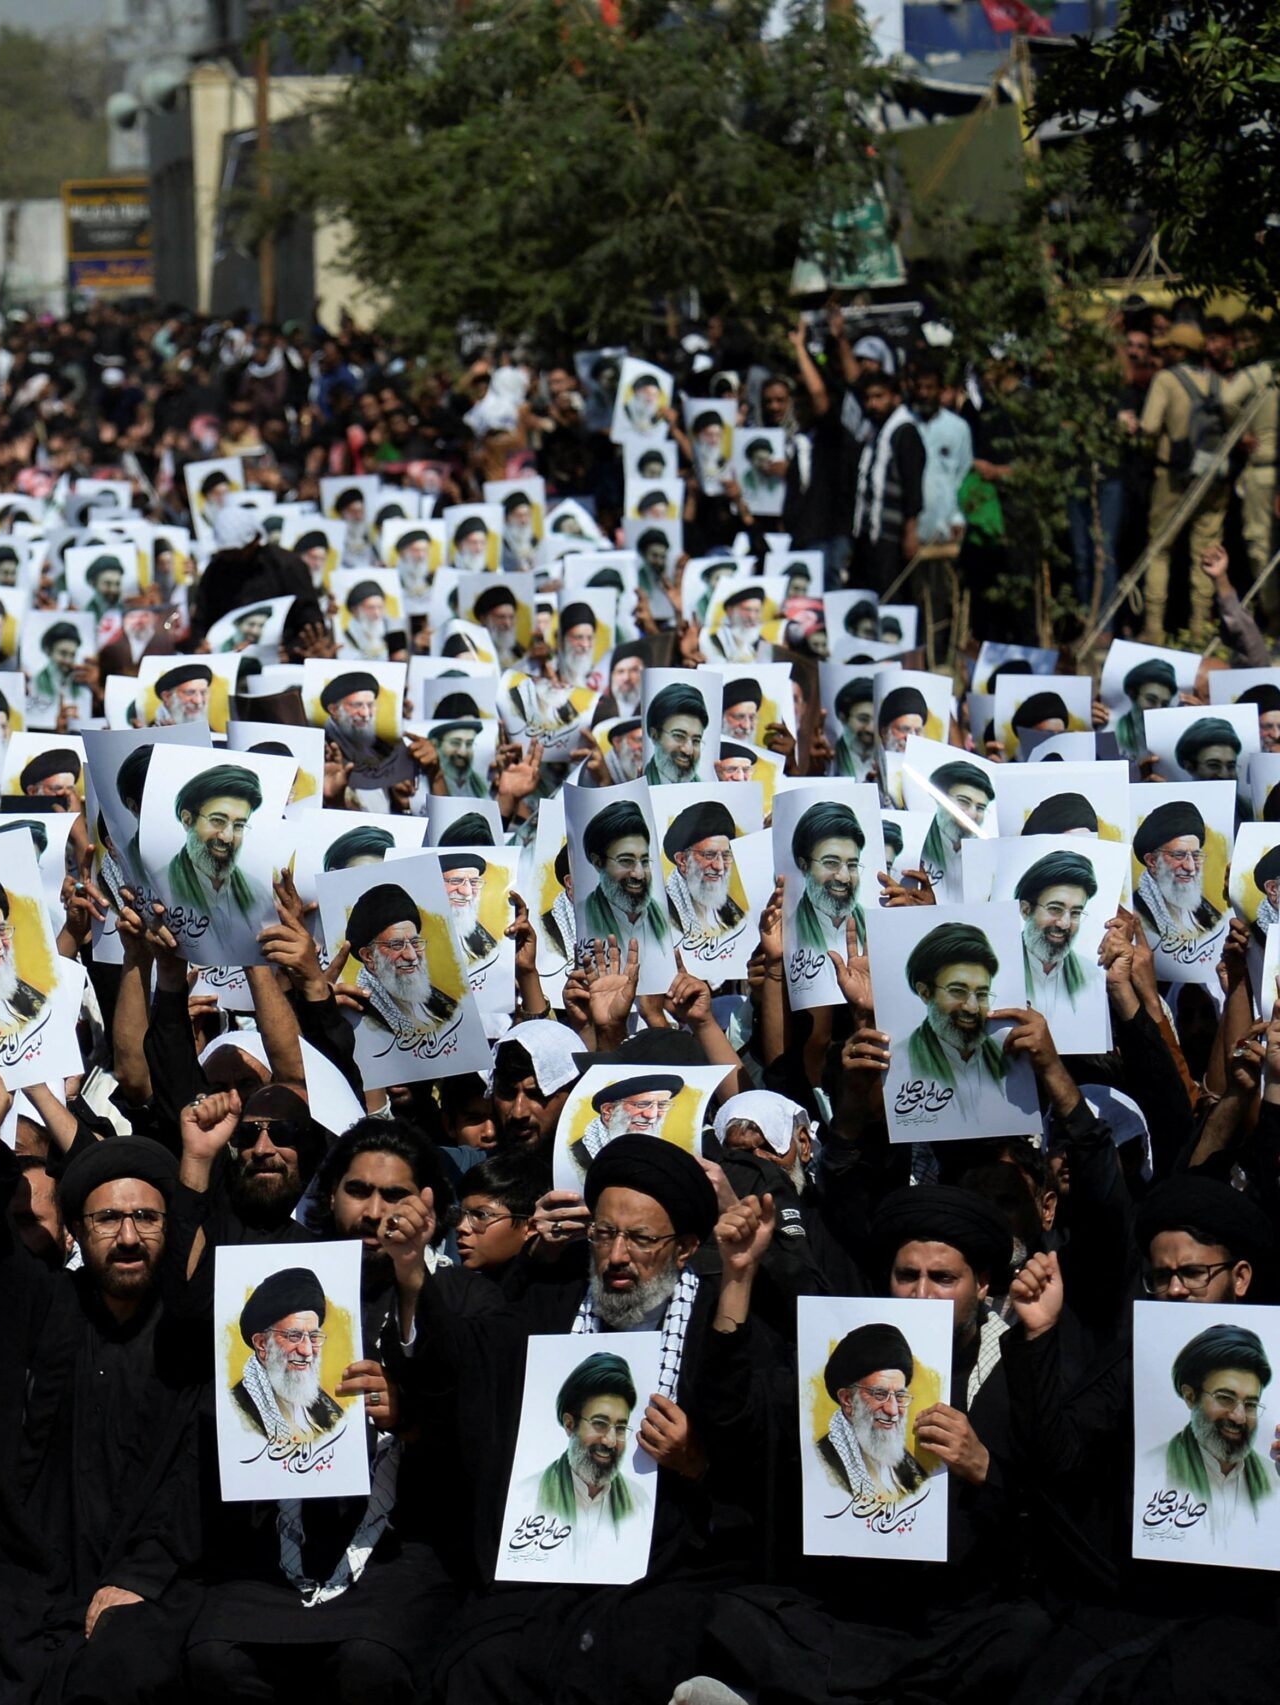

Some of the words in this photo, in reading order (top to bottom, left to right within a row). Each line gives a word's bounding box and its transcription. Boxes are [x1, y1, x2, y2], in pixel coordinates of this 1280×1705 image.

[924, 1081, 953, 1111] صالح
[1174, 1492, 1207, 1528] صالح
[539, 1517, 572, 1550] صالح
